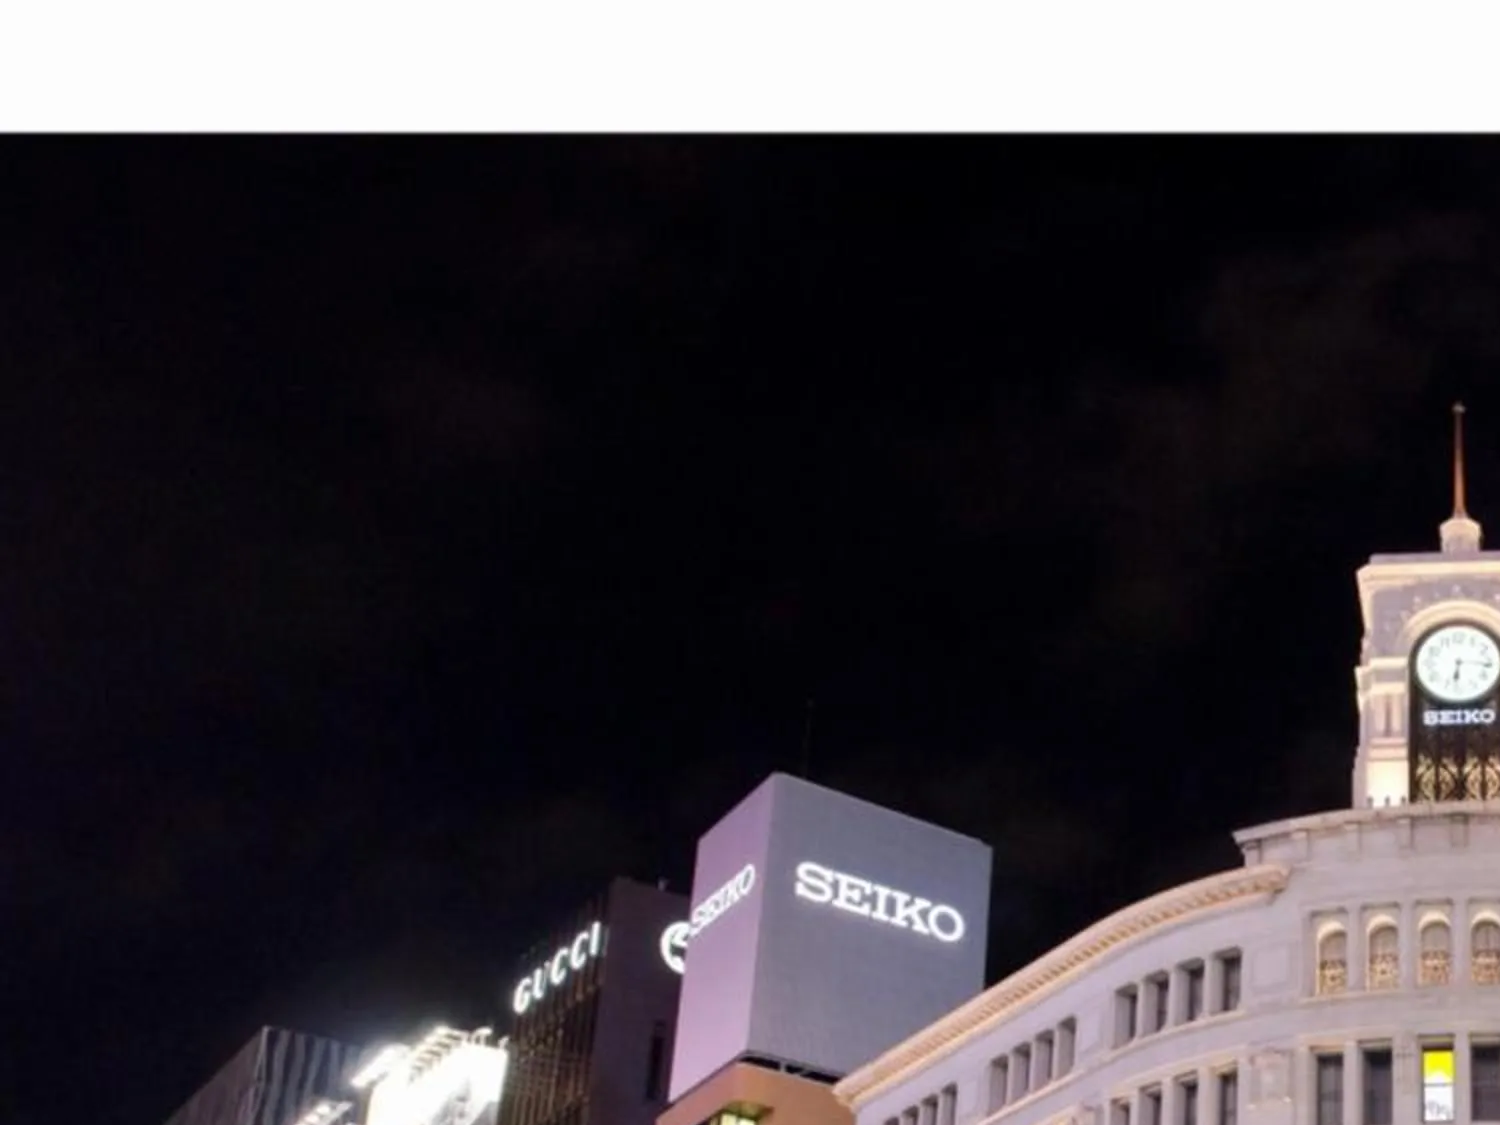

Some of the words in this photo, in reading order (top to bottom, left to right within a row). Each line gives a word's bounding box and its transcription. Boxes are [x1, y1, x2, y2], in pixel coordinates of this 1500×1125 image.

[1423, 709, 1496, 725] SEIKO
[691, 863, 755, 937] SEIKO
[795, 861, 965, 942] SEIKO
[513, 920, 601, 1013] GUCCI
